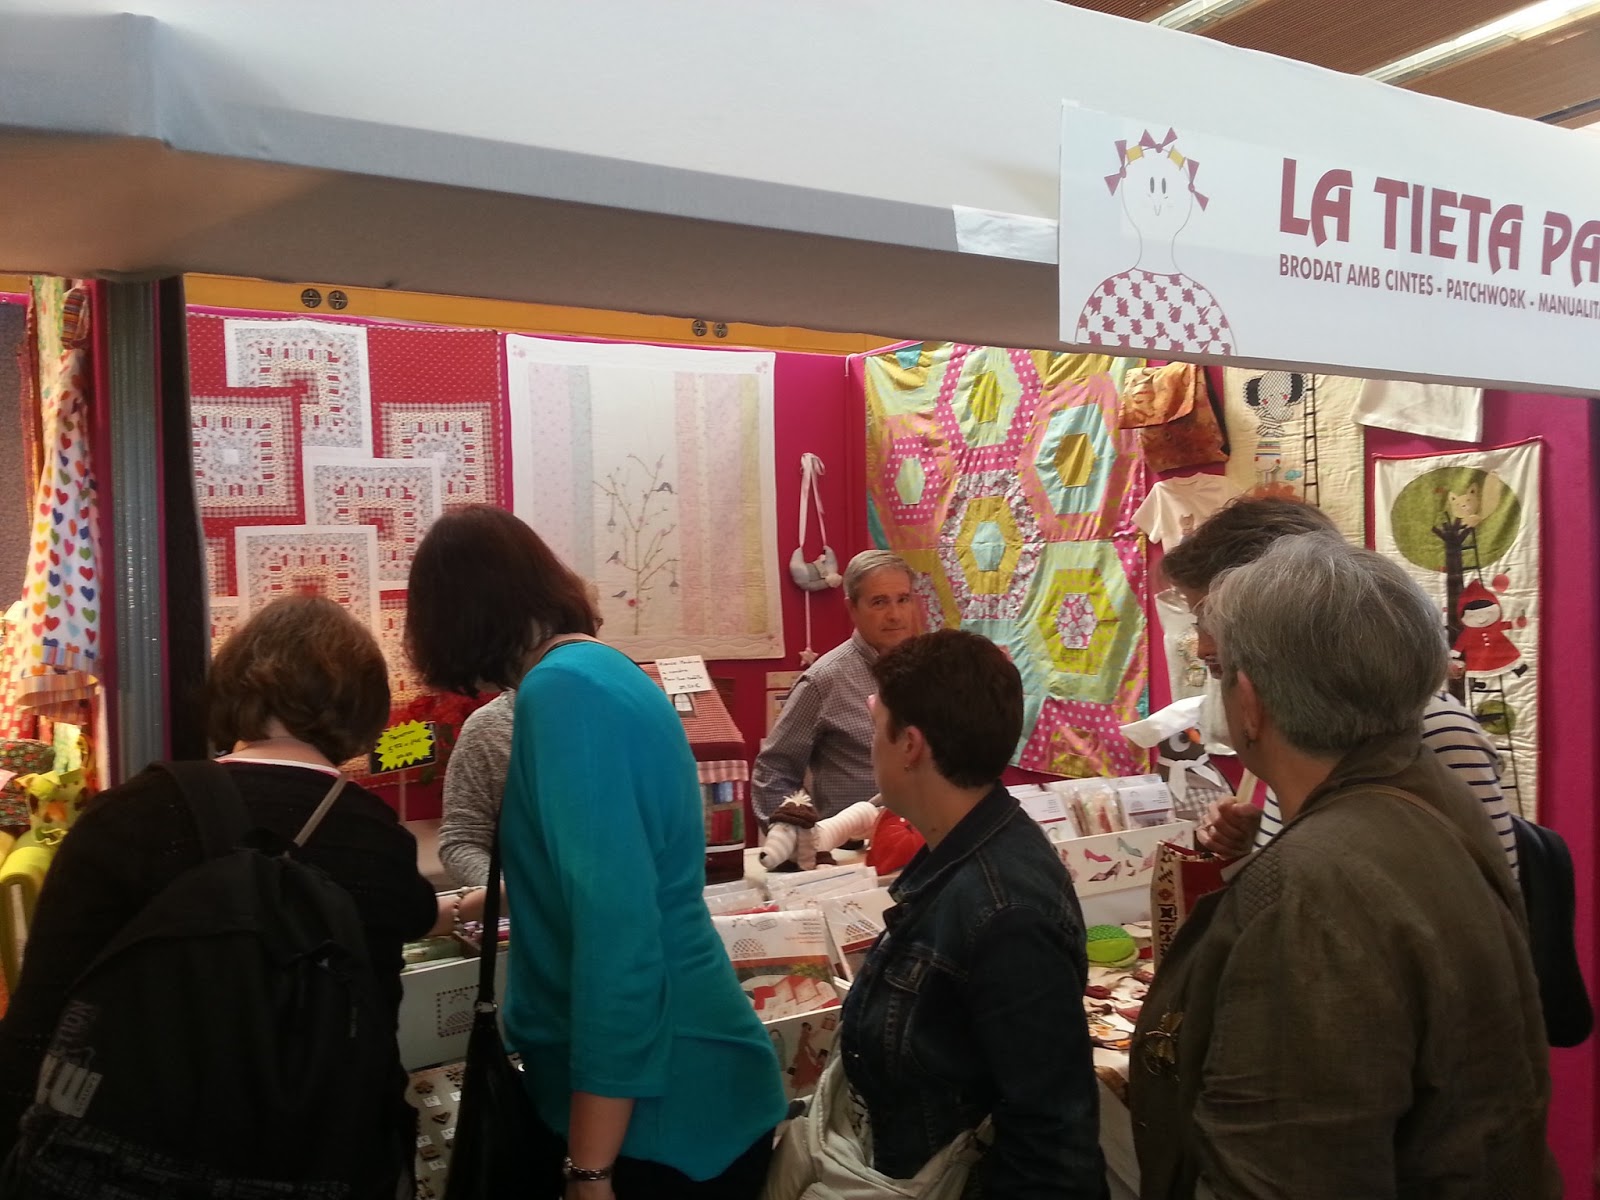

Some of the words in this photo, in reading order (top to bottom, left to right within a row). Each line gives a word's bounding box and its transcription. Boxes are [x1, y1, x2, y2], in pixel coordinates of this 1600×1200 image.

[1280, 157, 1353, 247] LA
[1373, 176, 1524, 275] TIETA
[1541, 210, 1600, 288] PA
[1279, 253, 1342, 283] BRODAT
[1347, 264, 1380, 288] AMB
[1385, 269, 1433, 295] CINTES
[1446, 278, 1526, 309] PATCHWORK
[1538, 292, 1600, 319] MANUALIT
